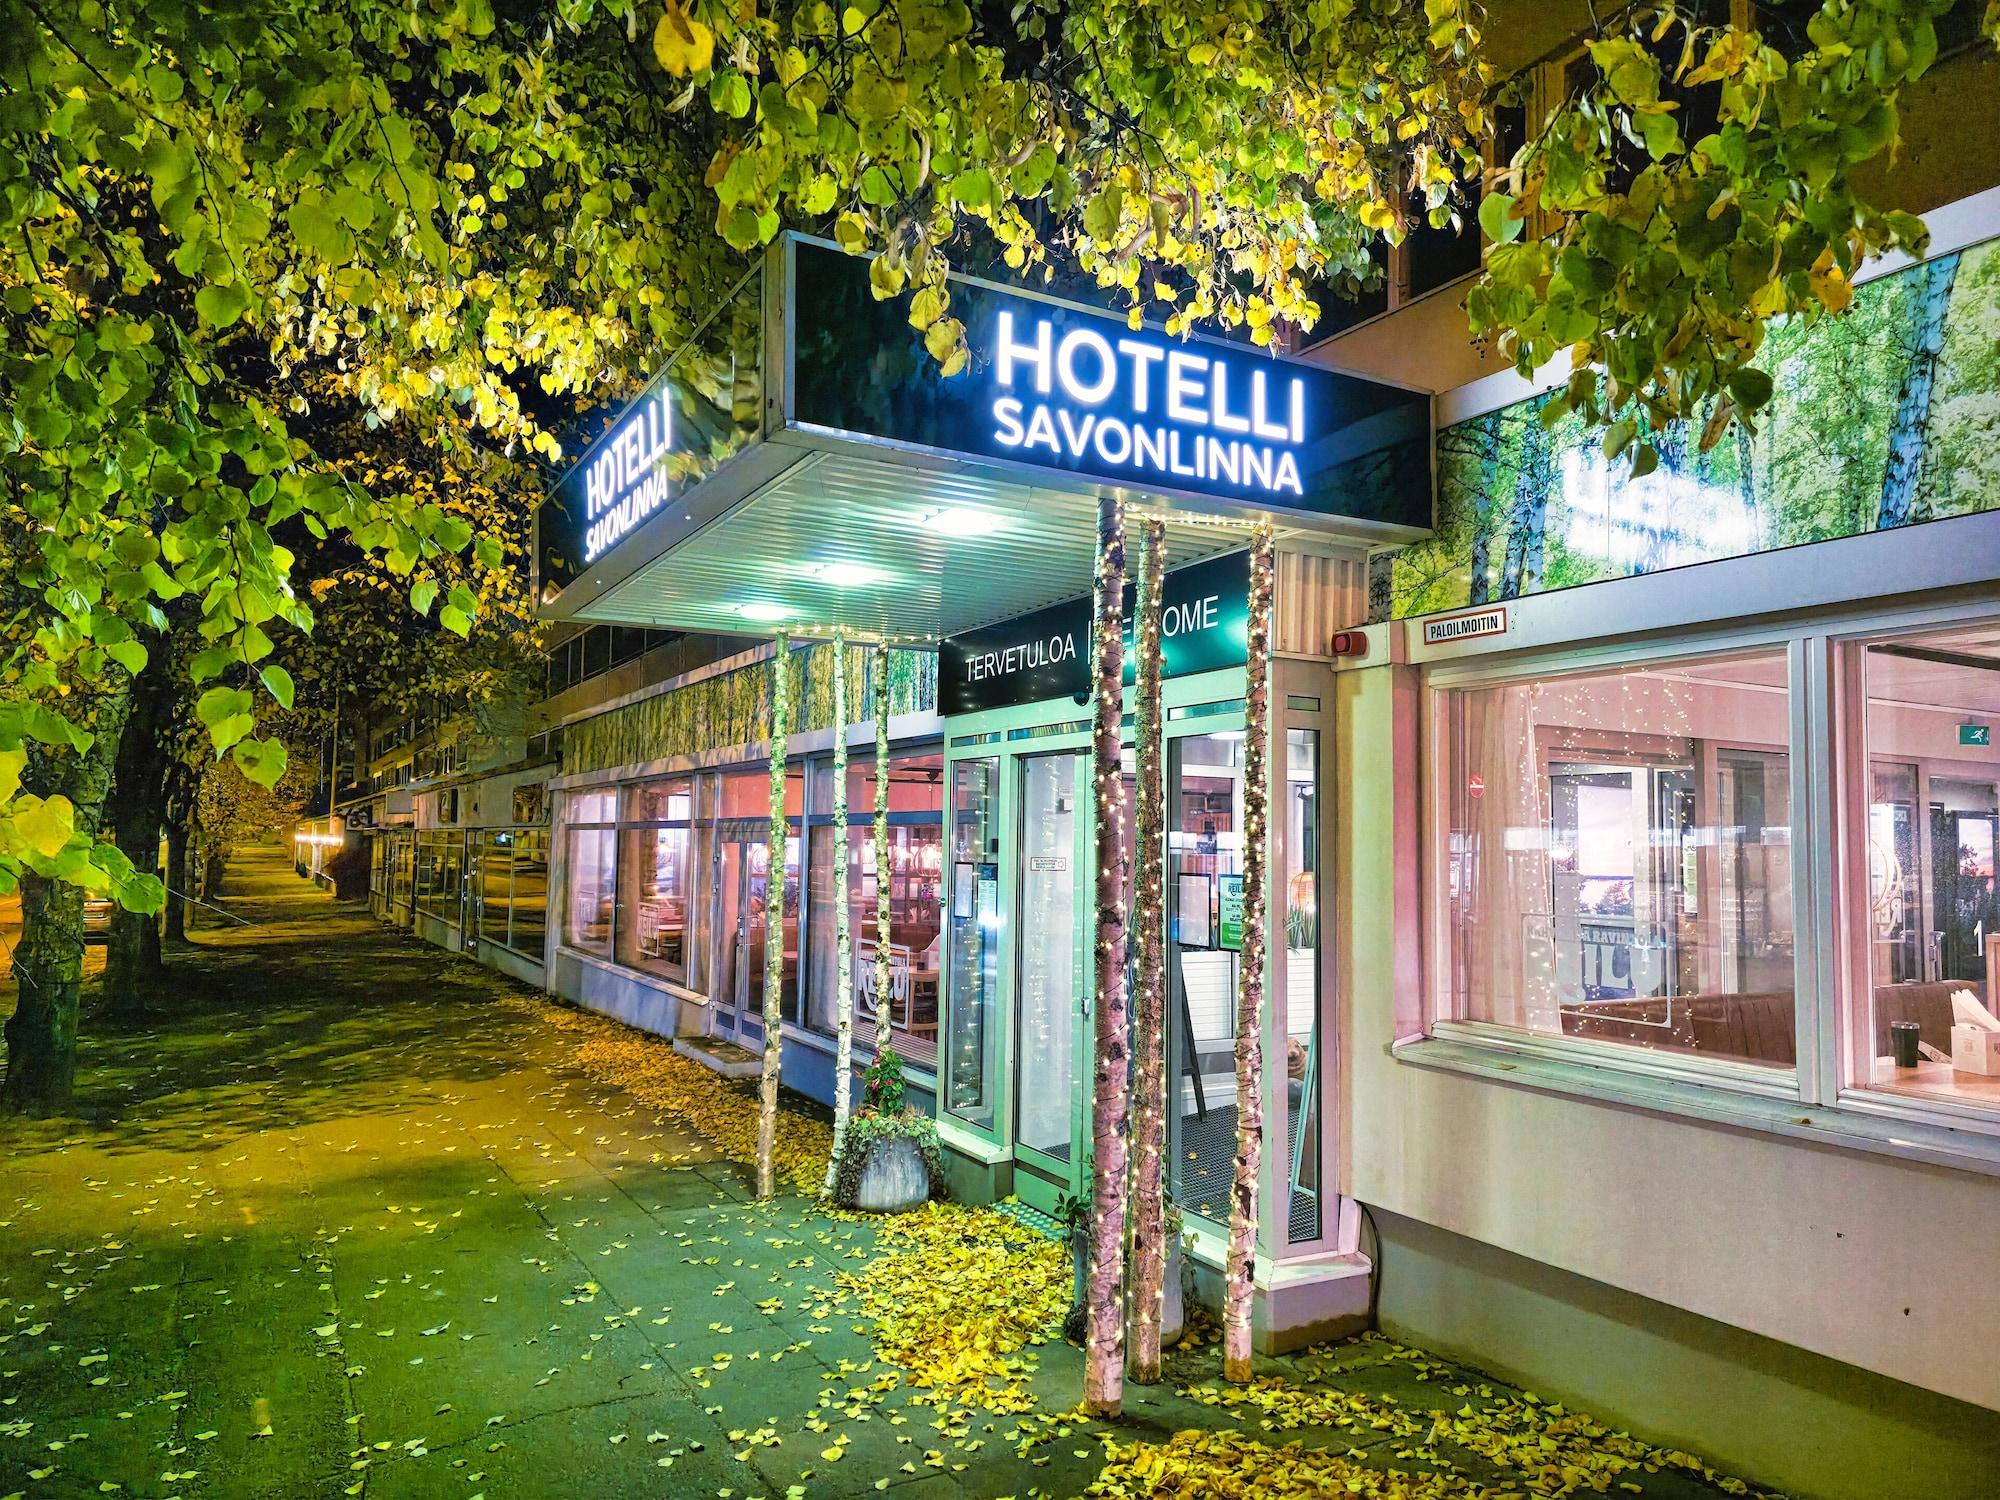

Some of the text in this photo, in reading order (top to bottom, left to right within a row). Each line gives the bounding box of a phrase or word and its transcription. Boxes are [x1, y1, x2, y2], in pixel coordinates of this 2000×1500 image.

[995, 310, 1305, 443] HOTELLI
[585, 386, 673, 521] HOTELLI
[992, 396, 1304, 496] SAVONLINNA
[583, 463, 669, 562] SAVONLINNA
[965, 632, 1076, 682] TERVETULOA
[1430, 615, 1498, 639] PALOILMOITIN
